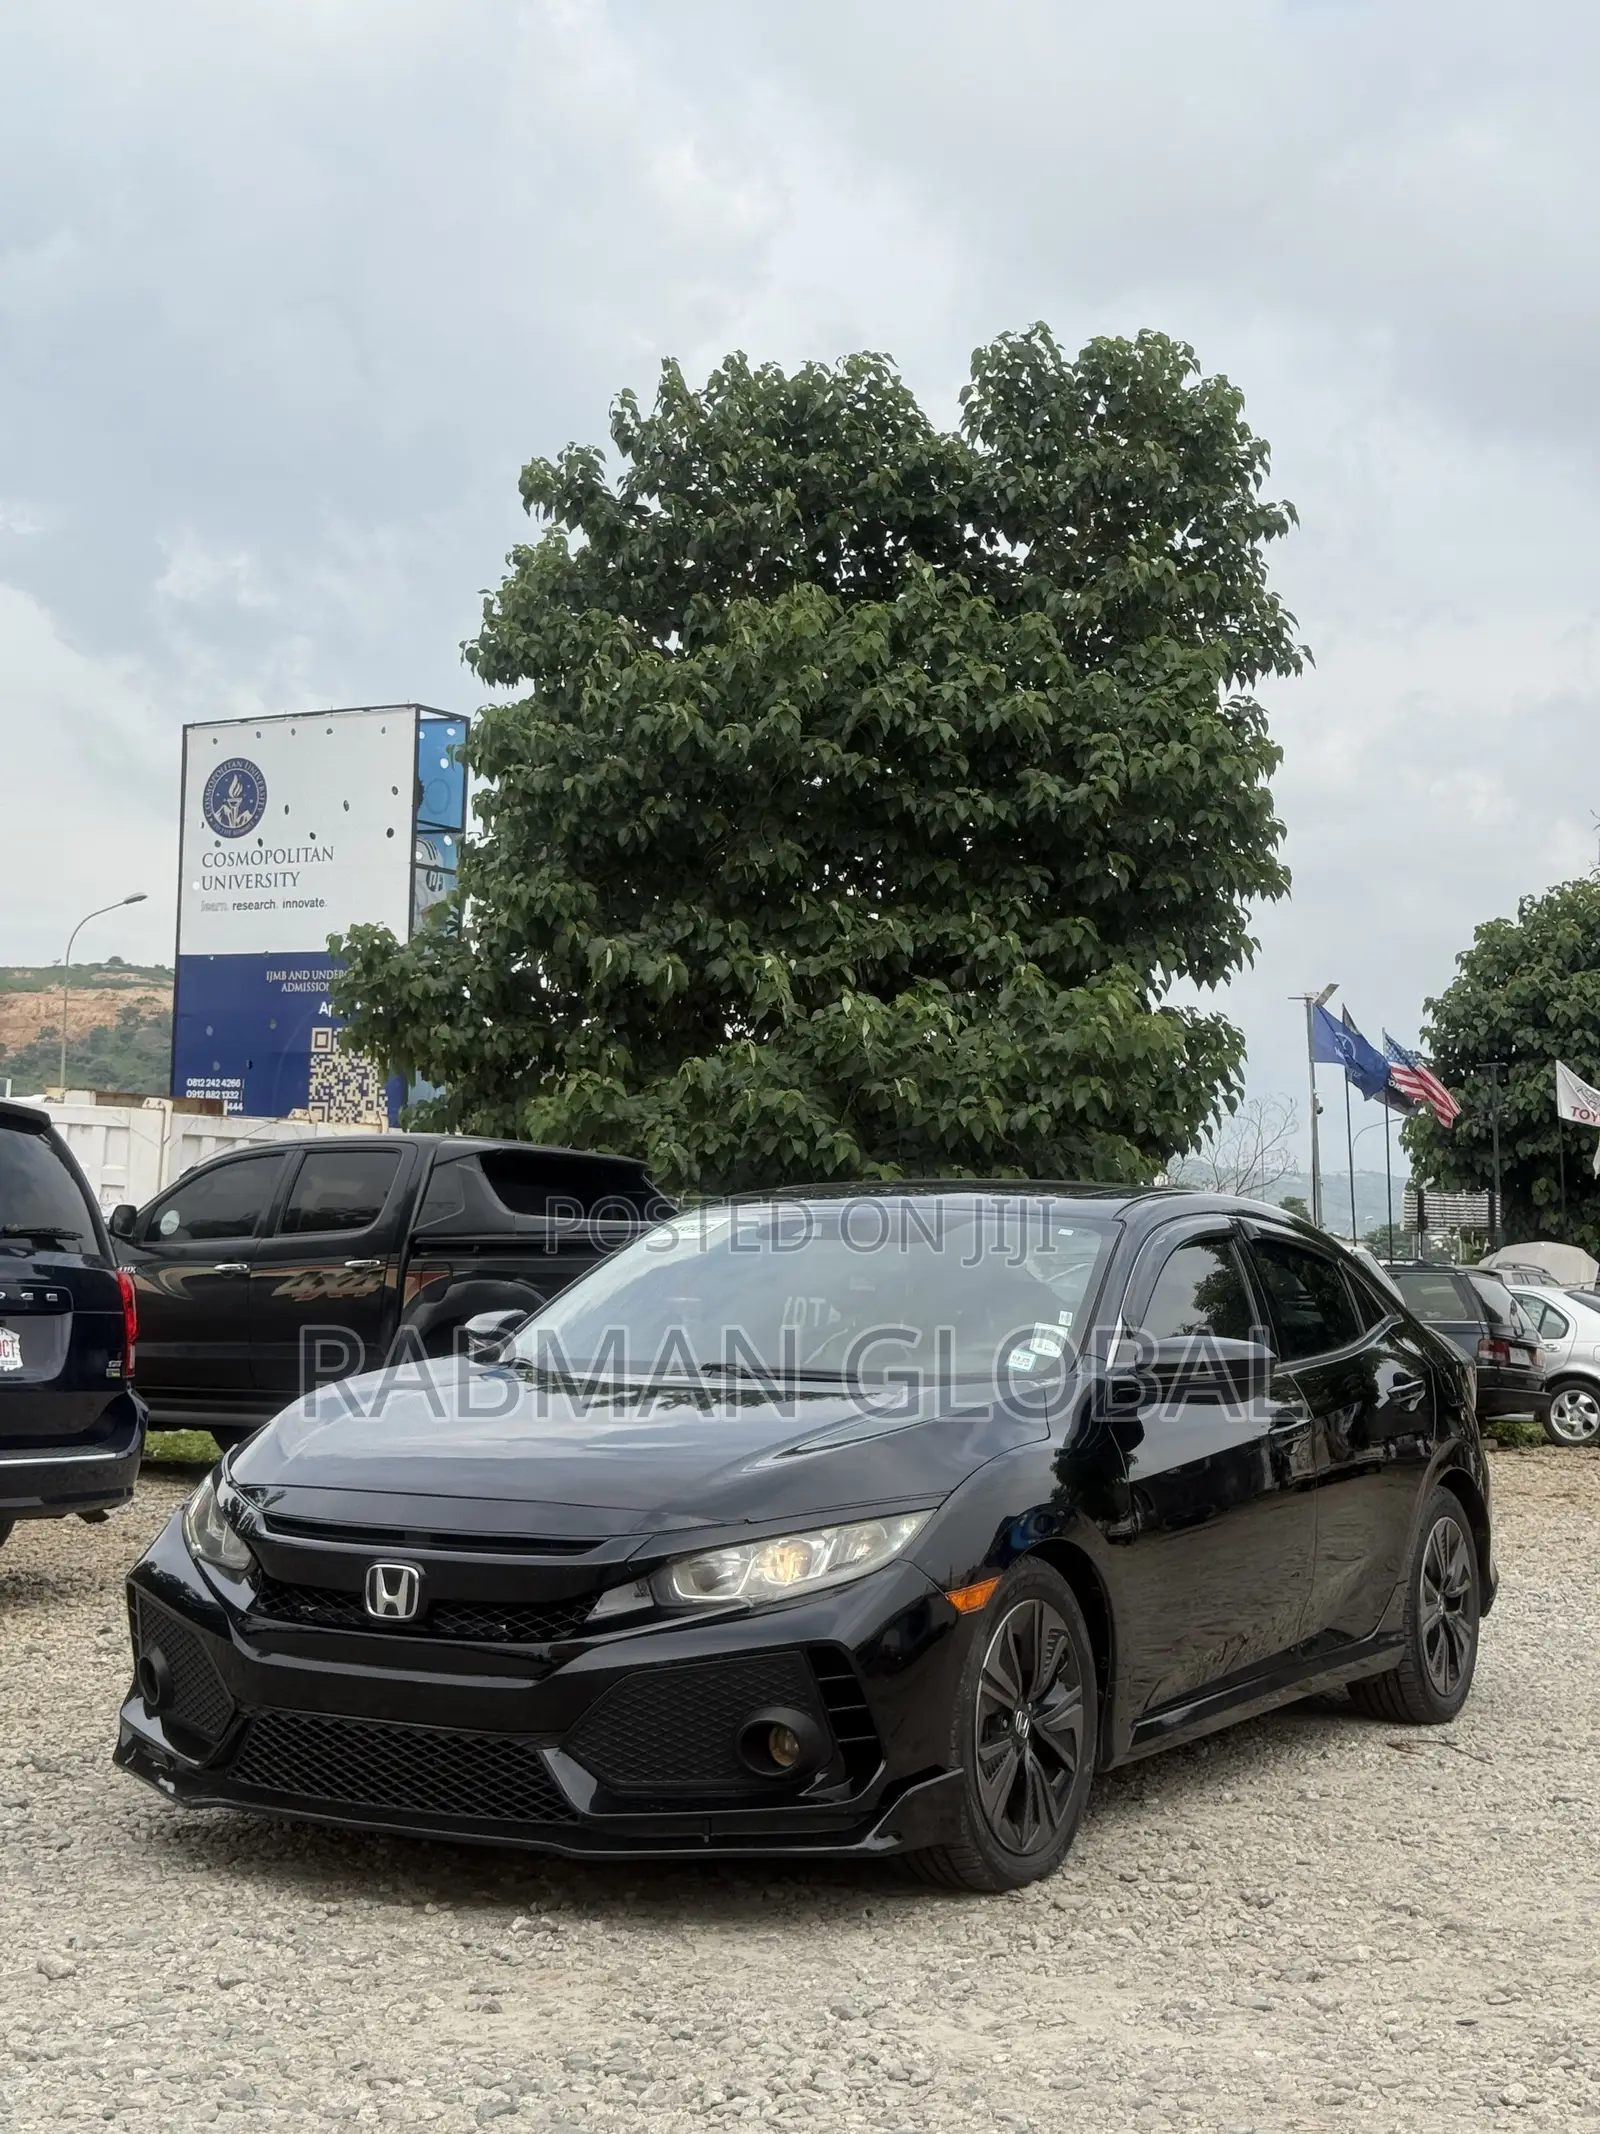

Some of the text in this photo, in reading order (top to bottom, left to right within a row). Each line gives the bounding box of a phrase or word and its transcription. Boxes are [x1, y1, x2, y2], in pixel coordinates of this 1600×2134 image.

[202, 846, 335, 868] COSMOPOLITAN
[201, 871, 301, 891] UNIVERSITY
[266, 970, 287, 983] IJMB
[288, 970, 310, 980] AND
[206, 1078, 221, 1087] 242
[1570, 1105, 1600, 1122] TOY
